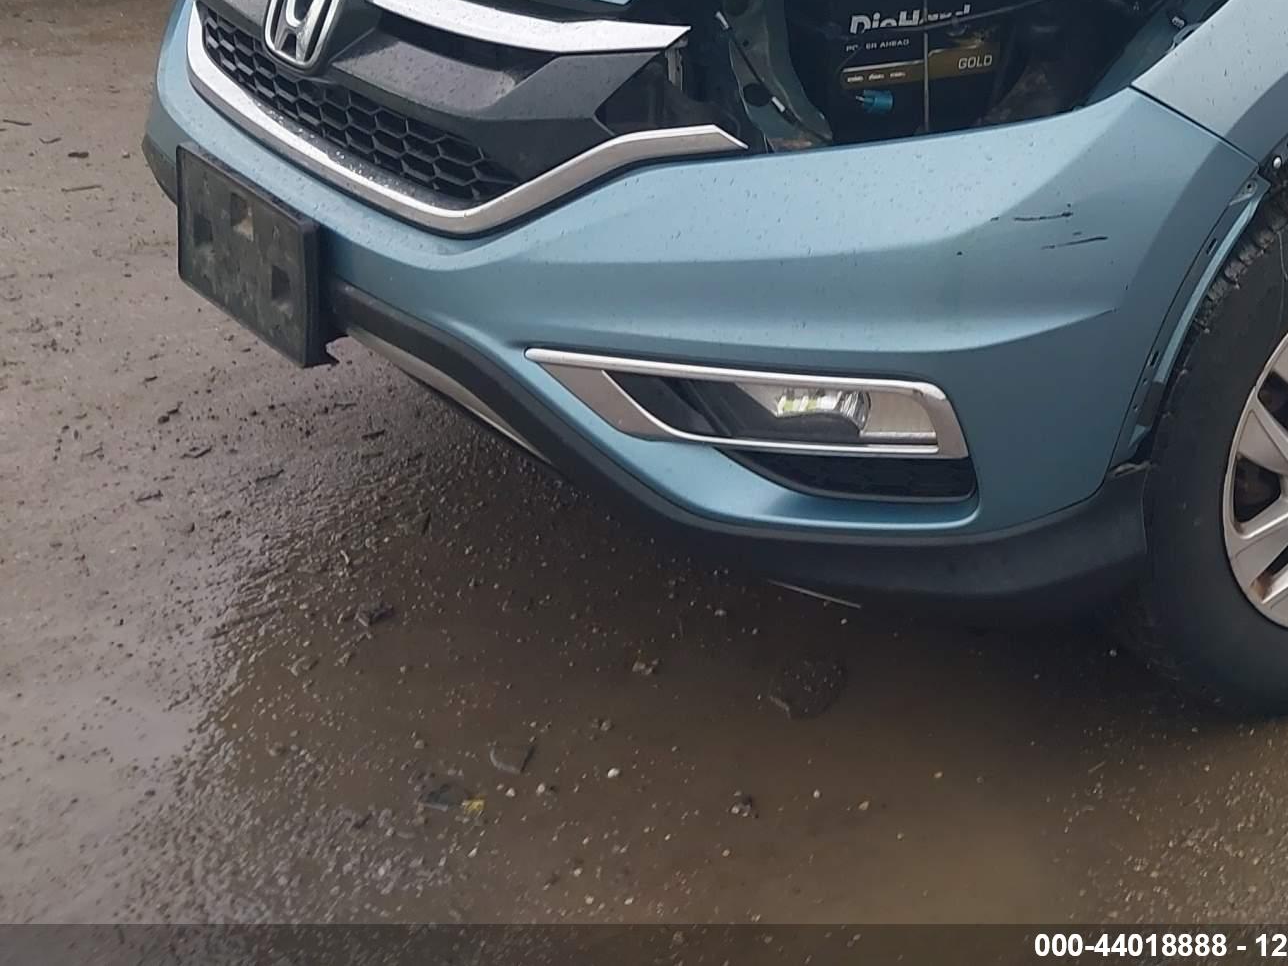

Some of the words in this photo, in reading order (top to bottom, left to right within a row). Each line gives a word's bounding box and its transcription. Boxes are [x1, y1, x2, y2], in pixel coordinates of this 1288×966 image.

[846, 39, 878, 52] POER
[880, 38, 910, 49] AHEAD
[958, 54, 993, 70] GOLD
